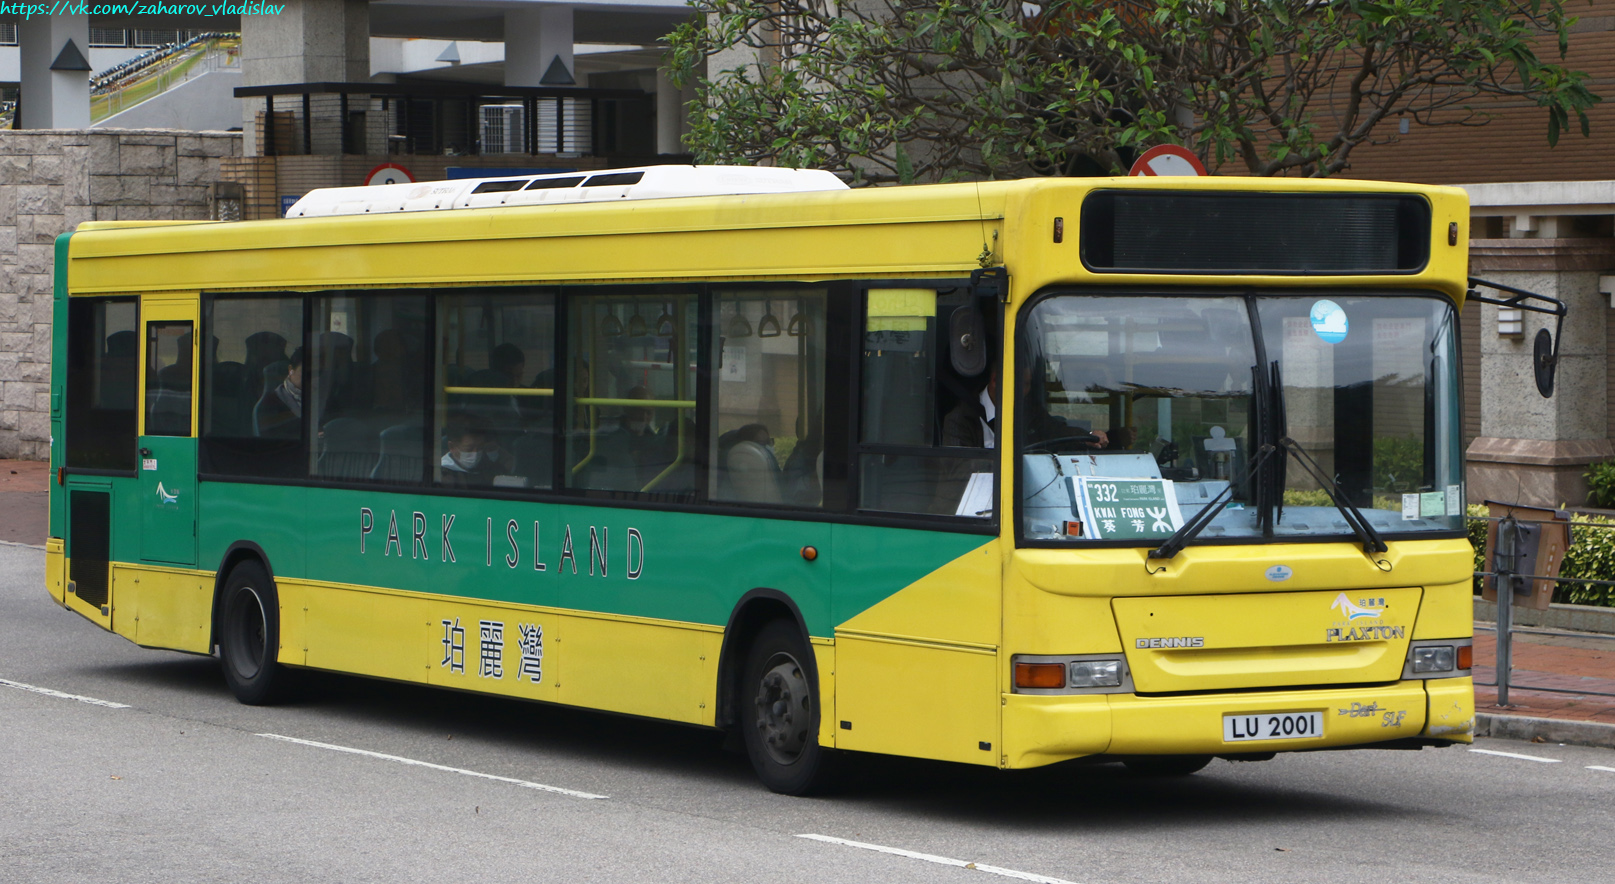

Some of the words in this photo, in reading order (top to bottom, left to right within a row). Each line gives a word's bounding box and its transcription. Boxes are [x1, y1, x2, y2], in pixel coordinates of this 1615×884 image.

[1095, 484, 1119, 502] 332
[1094, 507, 1117, 519] KWAI
[1120, 507, 1145, 519] FONG
[360, 507, 456, 563] PARK
[486, 516, 645, 580] ISLAND
[1135, 636, 1205, 649] DENNIS
[1326, 626, 1405, 642] PLAXTON
[440, 616, 544, 684] 珀麗灣
[1350, 701, 1379, 718] Dart
[1232, 717, 1259, 738] LU
[1267, 714, 1315, 737] 2001
[1382, 711, 1406, 727] SLF
